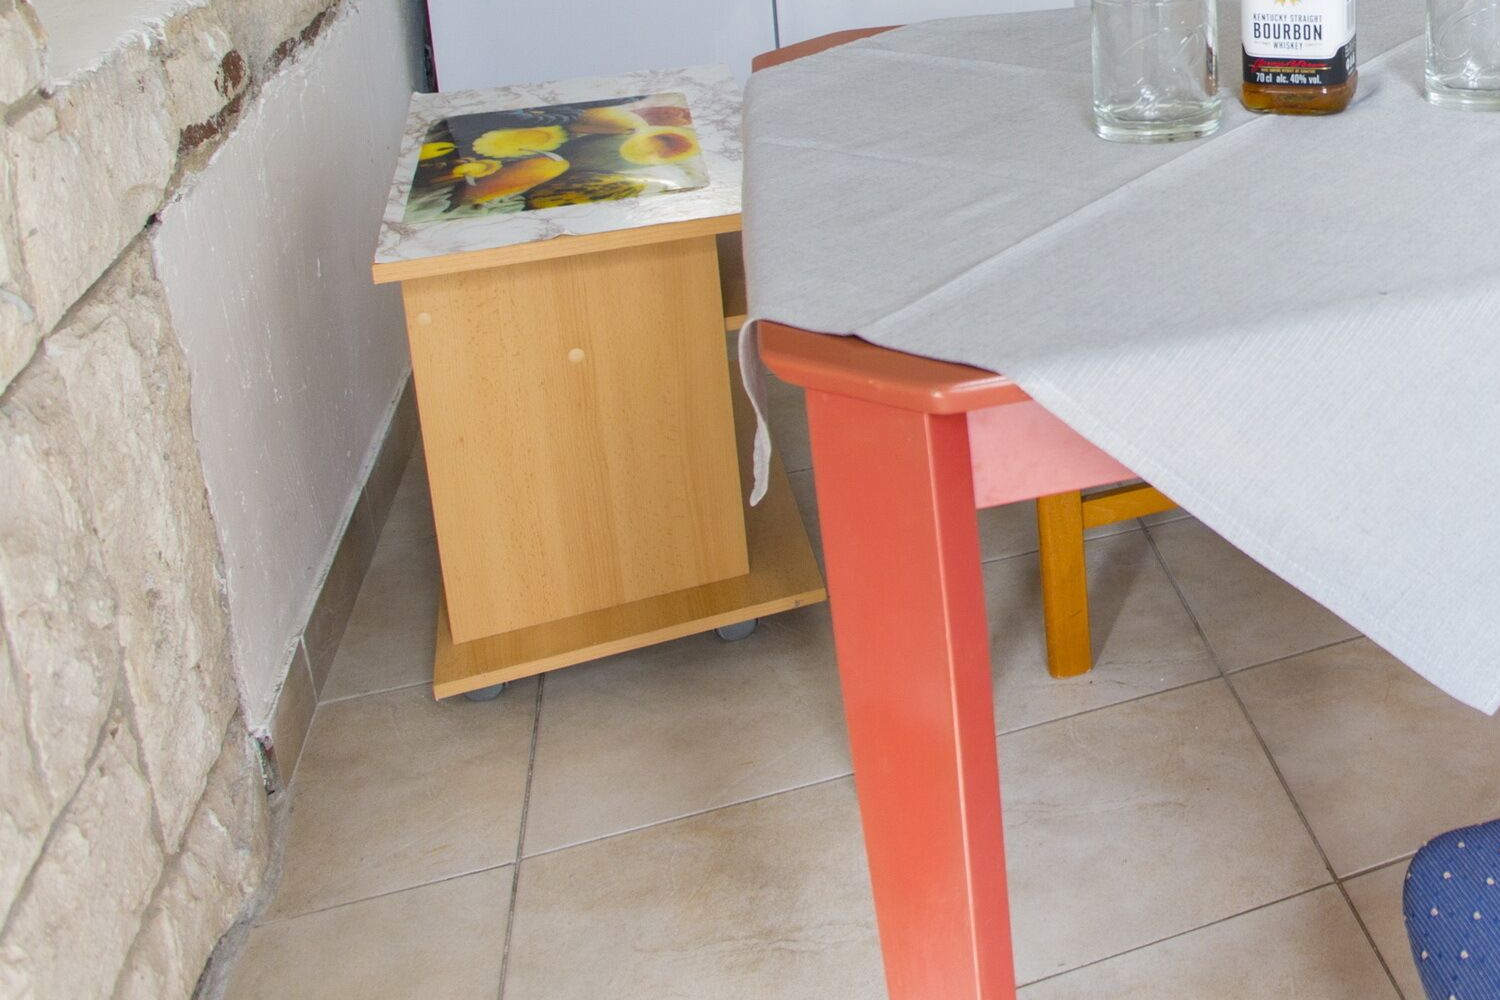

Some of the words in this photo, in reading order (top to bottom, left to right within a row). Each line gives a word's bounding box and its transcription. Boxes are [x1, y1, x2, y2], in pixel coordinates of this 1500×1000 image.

[1253, 13, 1288, 21] KENTUCKY
[1290, 14, 1322, 23] STRAIGHT
[1253, 22, 1322, 41] BOURBON
[1273, 41, 1303, 50] WHISKEY
[1255, 72, 1265, 82] 70
[1276, 73, 1289, 84] alc.
[1289, 73, 1307, 84] 40%
[1308, 74, 1322, 85] vol.
